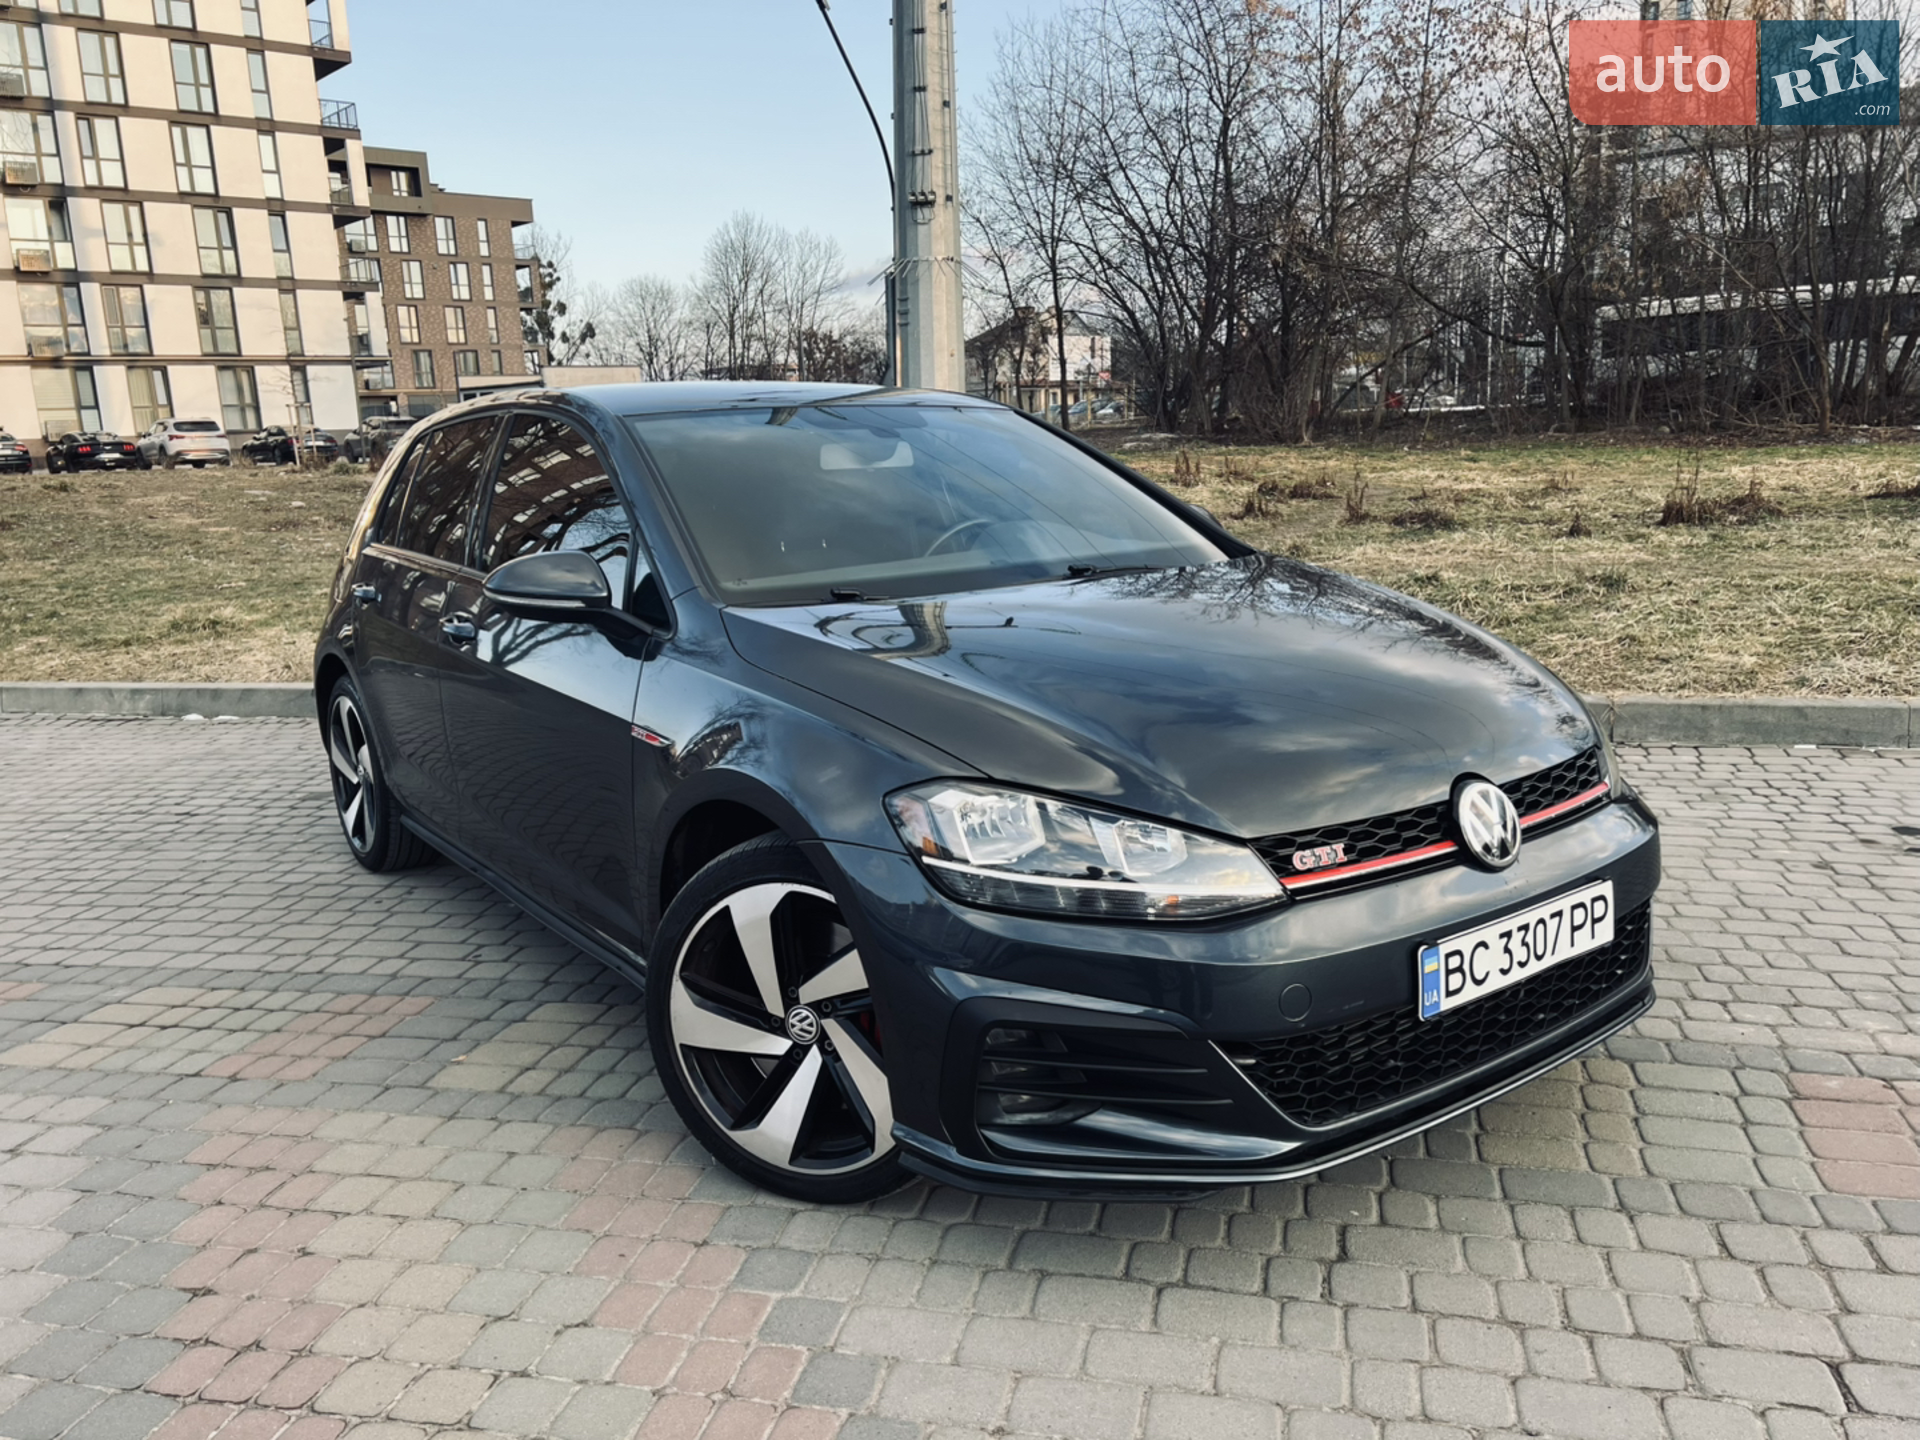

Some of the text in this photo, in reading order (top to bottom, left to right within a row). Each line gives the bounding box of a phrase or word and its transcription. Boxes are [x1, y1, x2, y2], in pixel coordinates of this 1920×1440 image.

[1292, 843, 1348, 871] GTI
[1444, 894, 1609, 999] BC 3307 PP
[1424, 989, 1440, 1006] UA
